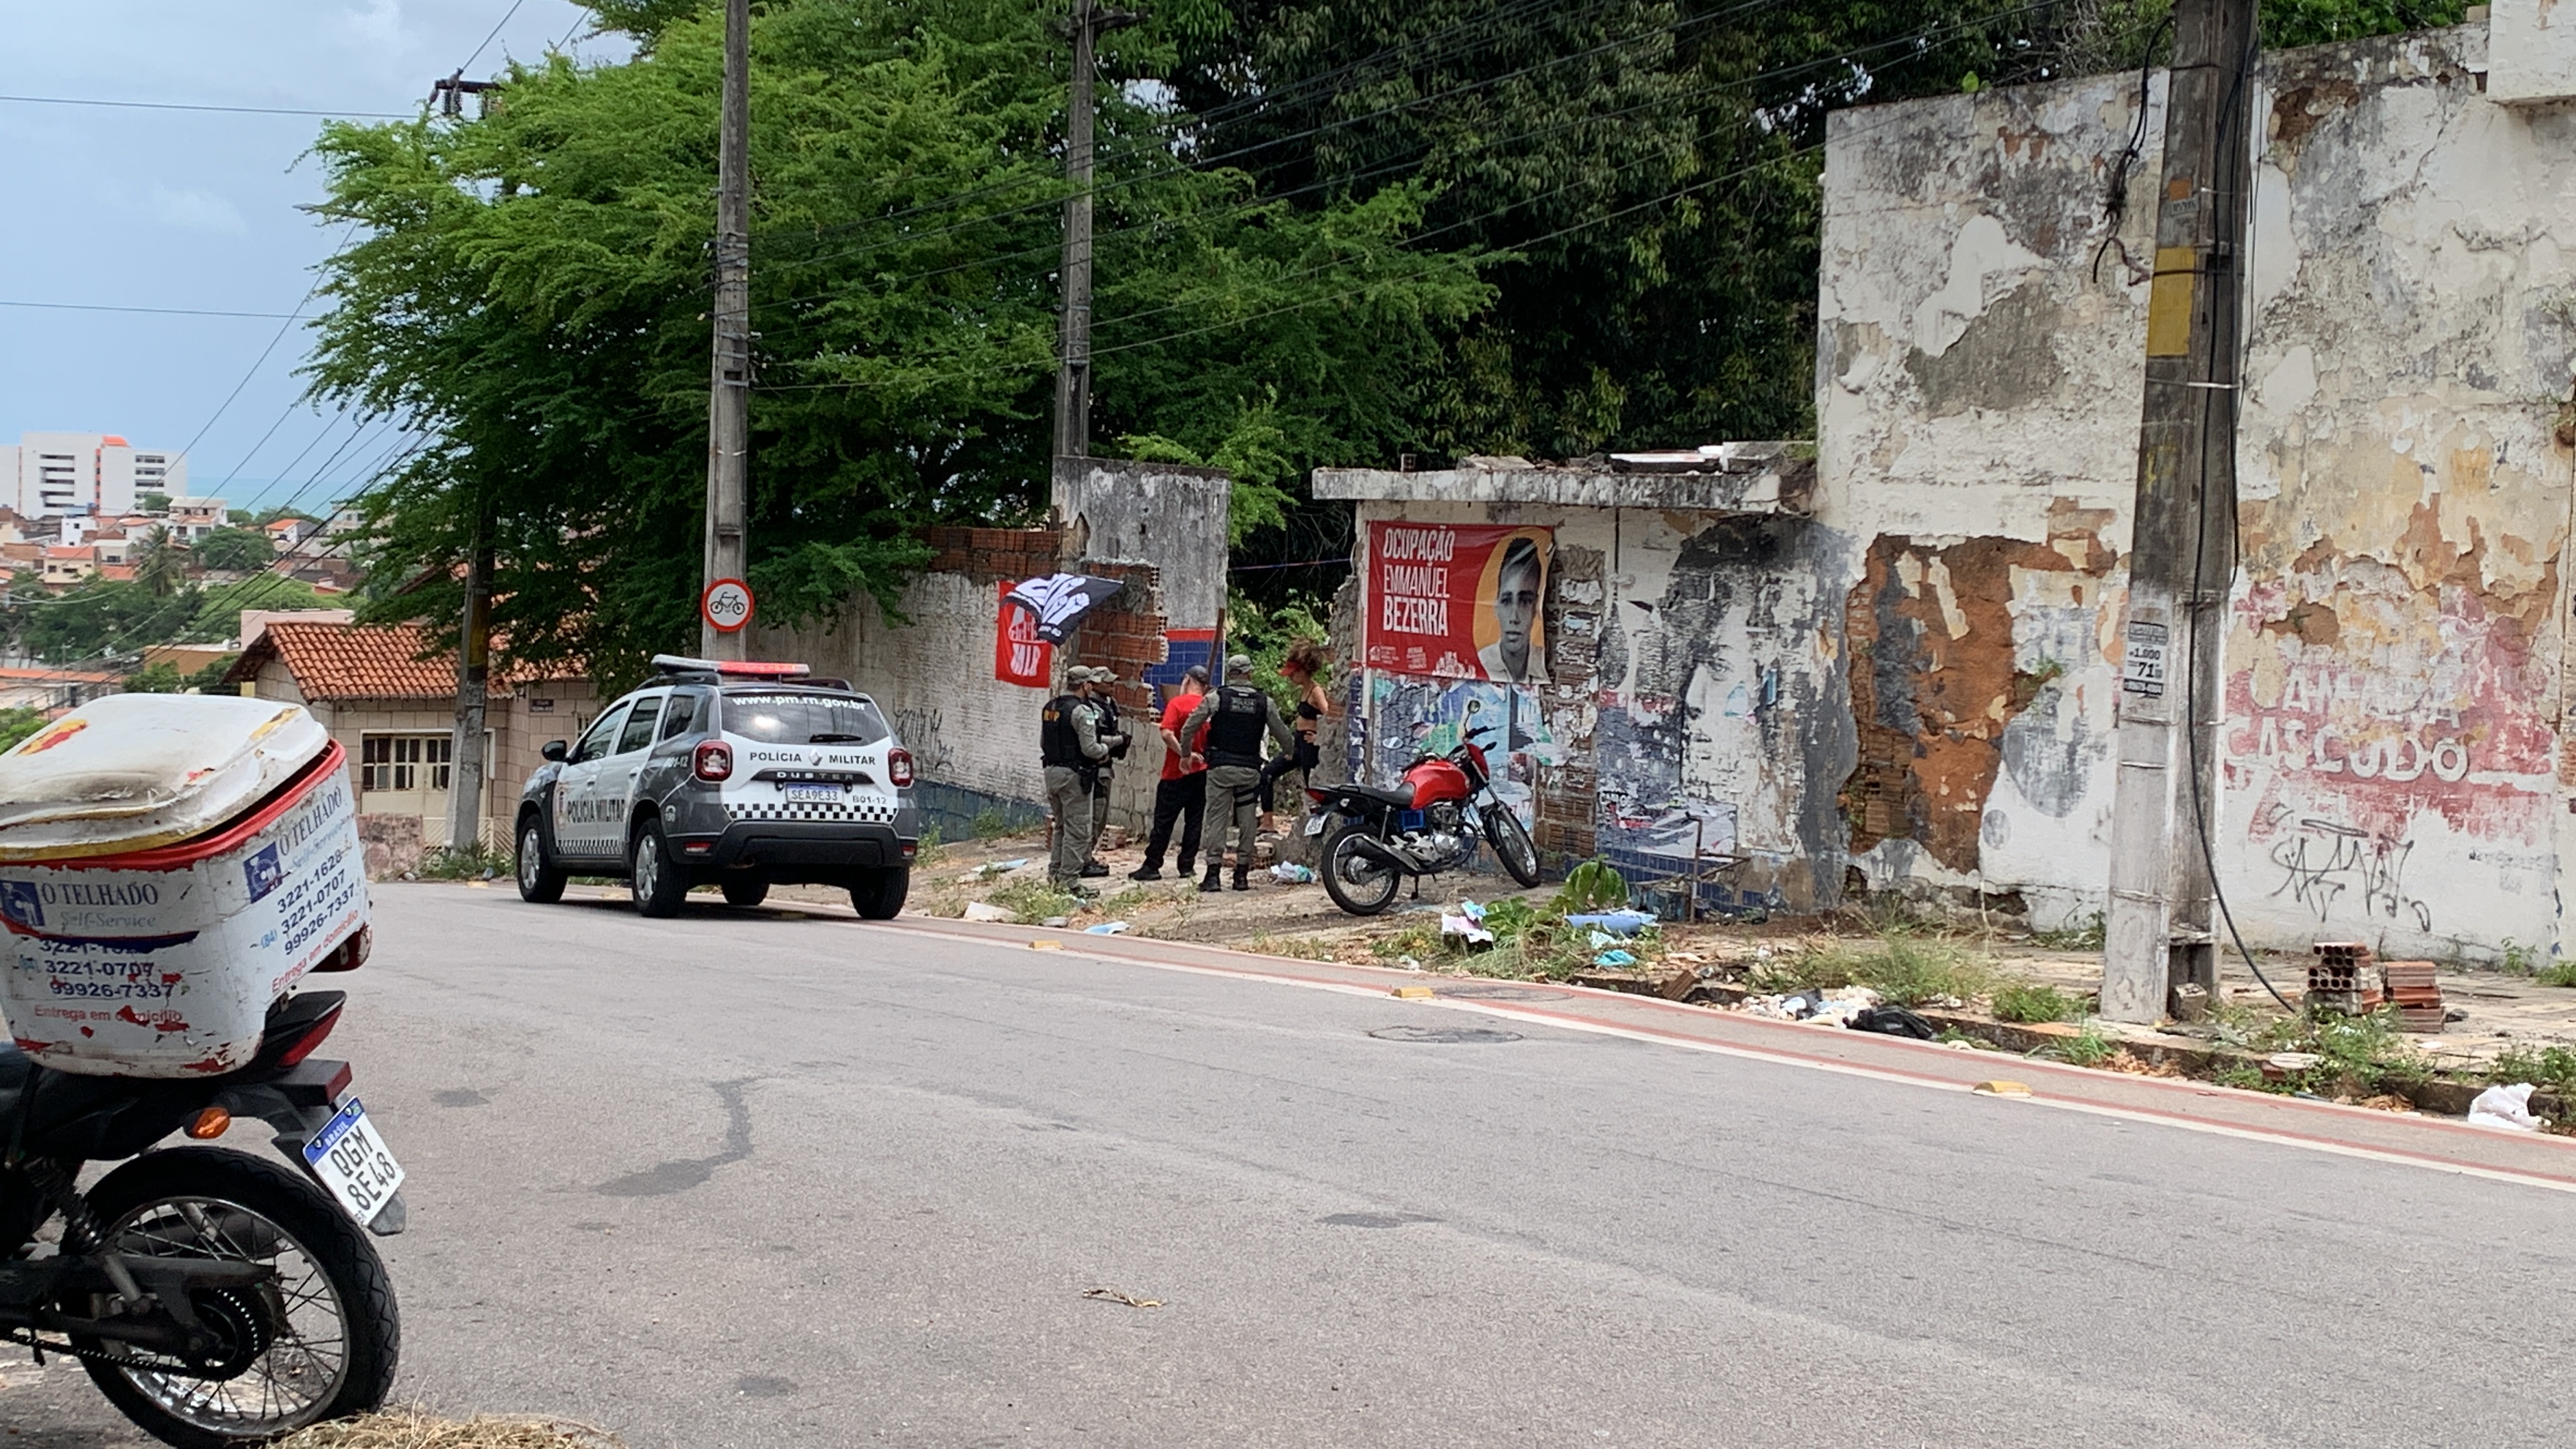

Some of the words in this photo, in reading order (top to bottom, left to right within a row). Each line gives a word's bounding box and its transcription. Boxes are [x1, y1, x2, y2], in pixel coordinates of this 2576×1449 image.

[1383, 525, 1456, 566] OCUPAÇÃO
[1384, 564, 1450, 598] EMMANUEL
[1383, 595, 1449, 637] BEZERRA
[2138, 662, 2154, 678] 71
[733, 695, 866, 711] www.pm.rn.gov.br
[749, 751, 803, 763] POLÍCIA
[828, 755, 876, 765] MILITAR
[776, 771, 854, 780] DUSTER
[791, 790, 839, 801] SEA9E33
[853, 795, 888, 805] B01-12
[279, 834, 290, 857] O
[291, 786, 342, 847] TELHADO
[41, 883, 56, 905] O
[58, 882, 160, 906] TELHADO
[277, 849, 343, 913] 3221-1628
[59, 911, 157, 929] Self-Service
[261, 929, 278, 949] (84)
[281, 869, 345, 935] 3221-0707
[284, 883, 356, 955] 99926-7337
[272, 959, 308, 993] Entrega
[308, 943, 322, 962] em
[34, 1006, 87, 1022] Entrega
[89, 1011, 111, 1021] em
[323, 1120, 350, 1147] BRASIL
[330, 1125, 373, 1179] QGM
[347, 1151, 396, 1211] 8E48
